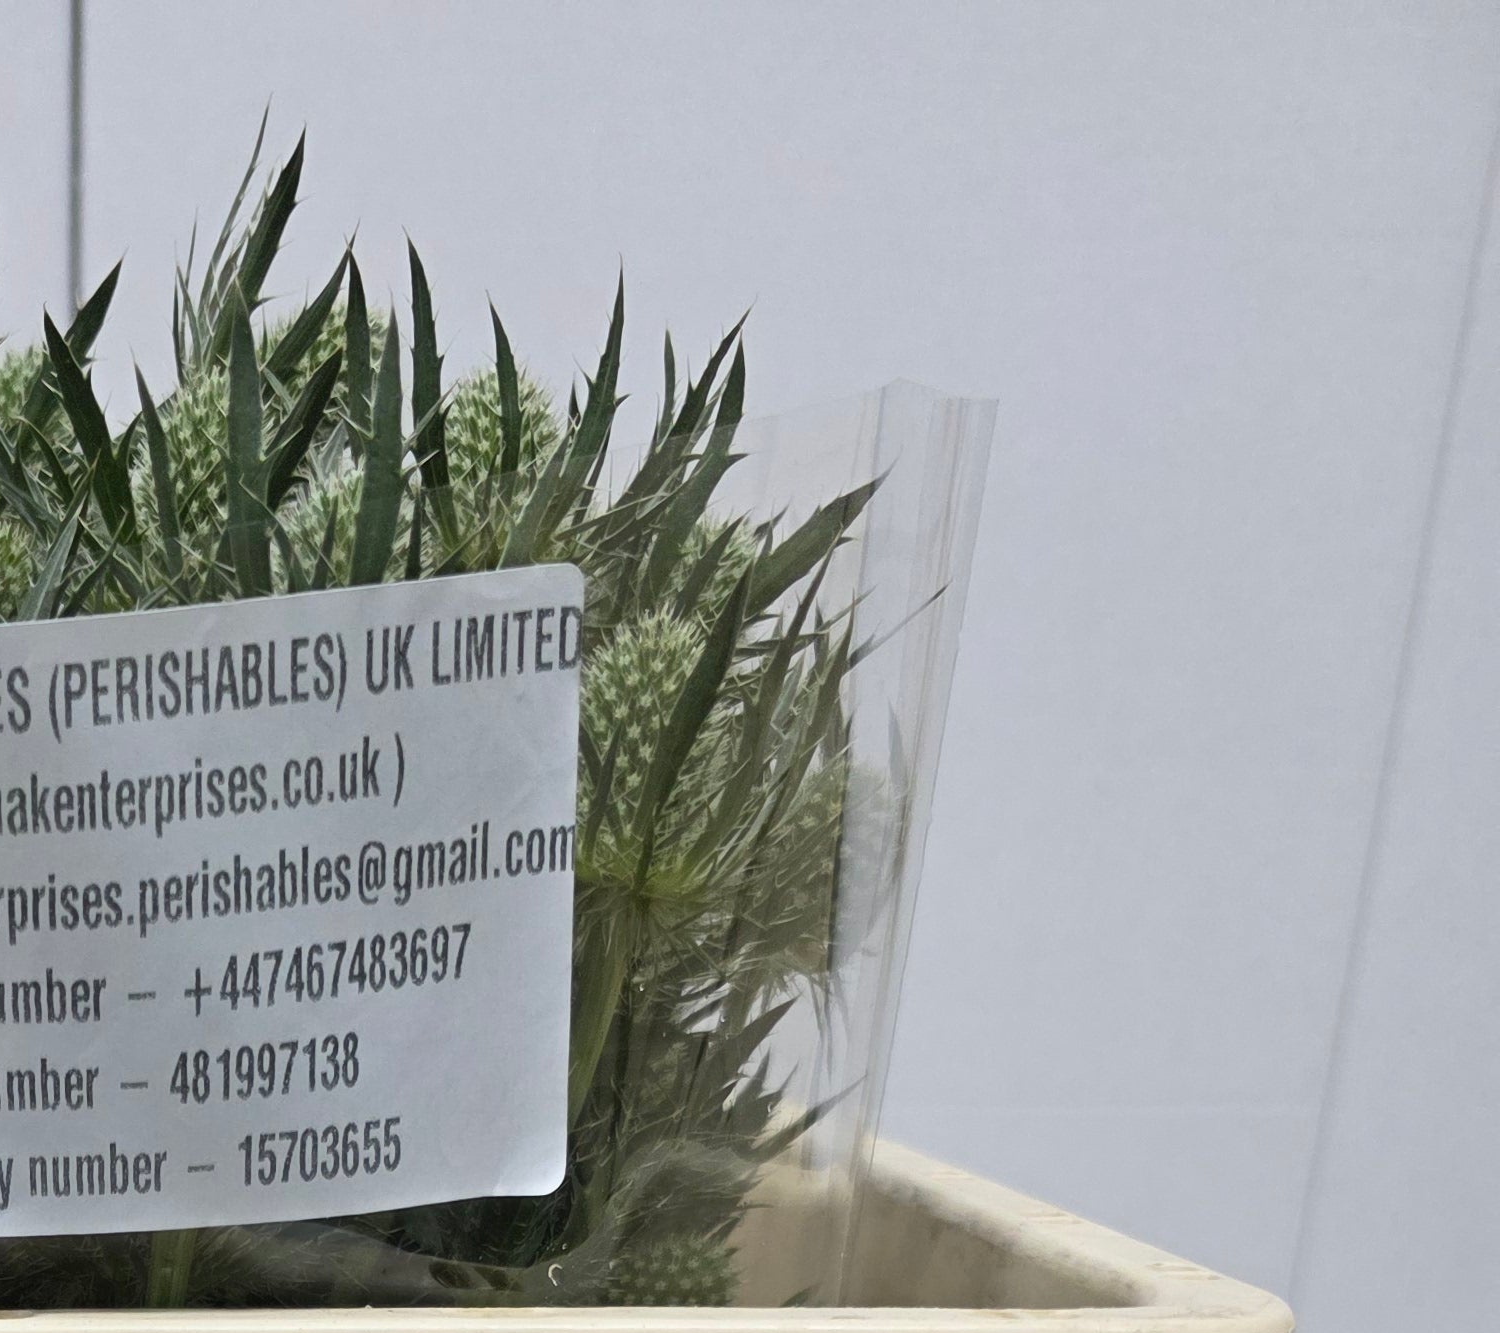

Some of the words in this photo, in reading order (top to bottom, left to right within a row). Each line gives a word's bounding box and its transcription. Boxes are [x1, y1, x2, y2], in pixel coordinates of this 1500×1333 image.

[48, 632, 348, 745] (PERISHABLES)
[365, 623, 416, 695] UK
[431, 605, 584, 687] LIMITED
[183, 922, 472, 1018] +447467483697
[169, 1031, 360, 1105] 481997138
[28, 1141, 168, 1198] number
[237, 1115, 402, 1187] 15703655
